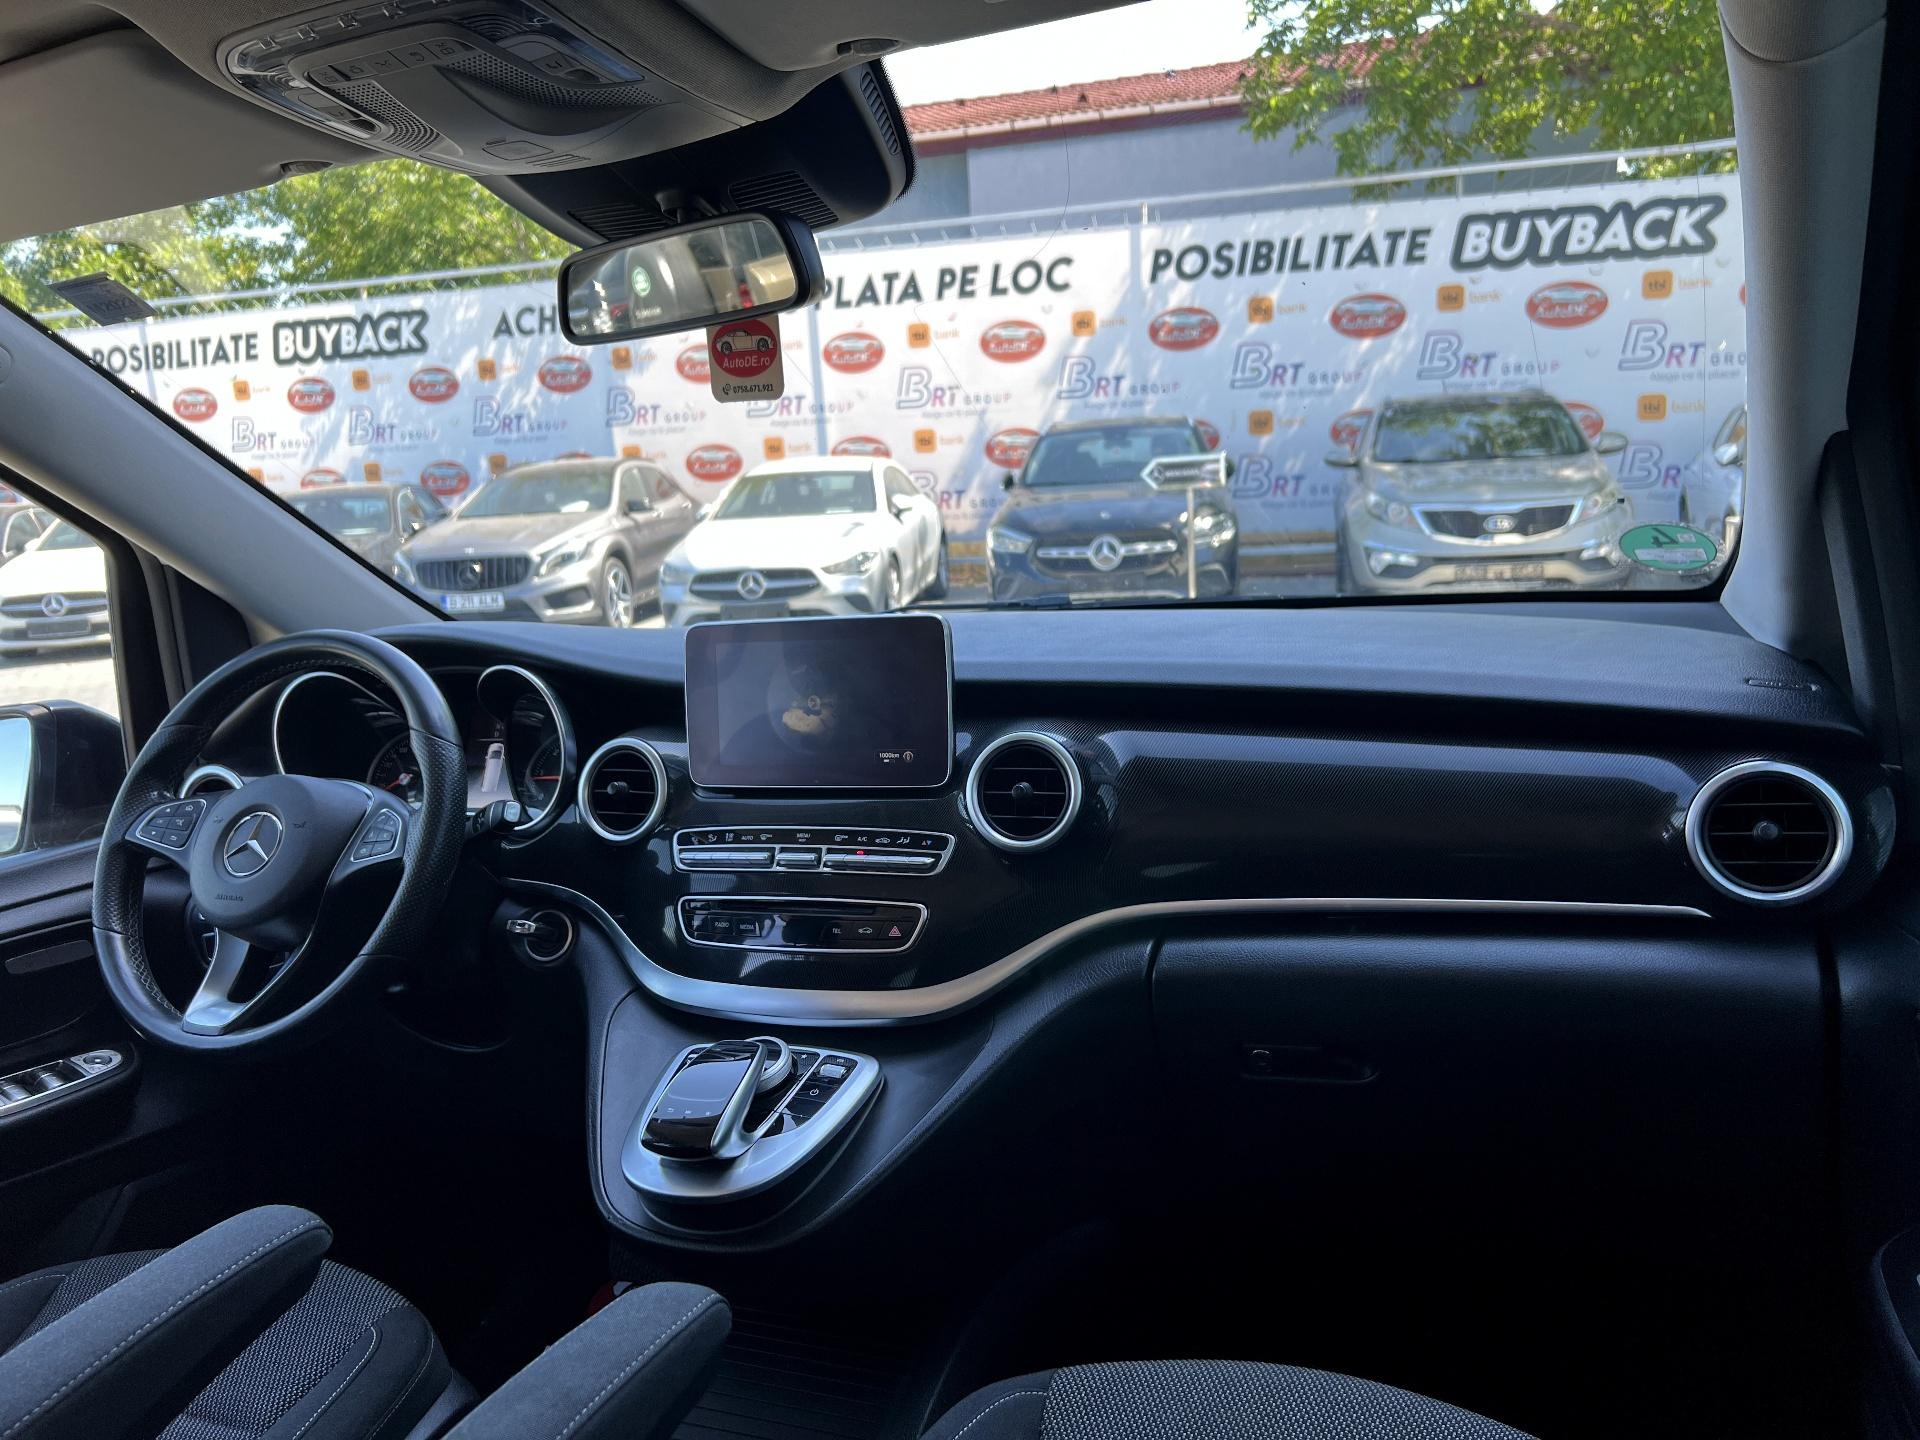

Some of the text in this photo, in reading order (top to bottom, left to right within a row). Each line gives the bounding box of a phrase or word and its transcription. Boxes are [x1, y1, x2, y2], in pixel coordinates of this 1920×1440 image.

[1150, 195, 1727, 284] POSIBILITATE BUYBACK
[936, 264, 980, 302] PE
[989, 256, 1074, 298] LOC
[92, 309, 429, 374] POSIBILITATE BUYBACK
[722, 355, 770, 369] AutoDE.ro
[1416, 329, 1562, 380] BRT GROUP
[1618, 319, 1747, 371] BRT GRO
[896, 366, 1012, 409] BRT GROUP
[1056, 355, 1127, 400] BRT
[1230, 342, 1363, 389] BRT GROUP
[606, 386, 661, 427] BRT
[1618, 440, 1683, 489] BR
